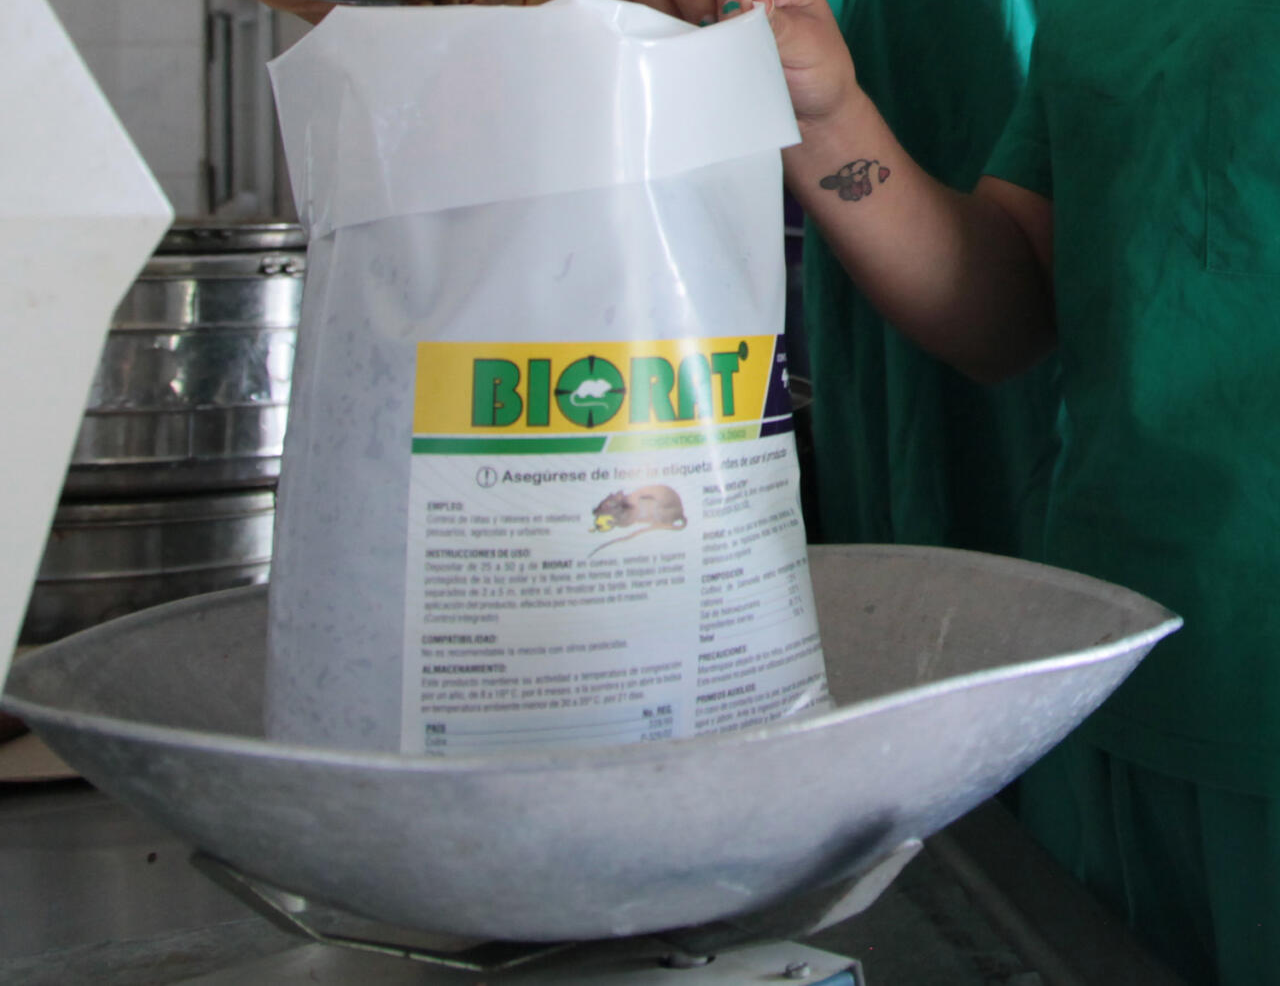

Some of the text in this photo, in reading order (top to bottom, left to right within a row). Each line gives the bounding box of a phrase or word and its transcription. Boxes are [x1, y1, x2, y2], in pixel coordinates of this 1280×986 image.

[471, 347, 742, 428] BIORAT
[502, 468, 587, 486] Asegúrese
[591, 467, 609, 481] de
[662, 460, 712, 477] etiqueta
